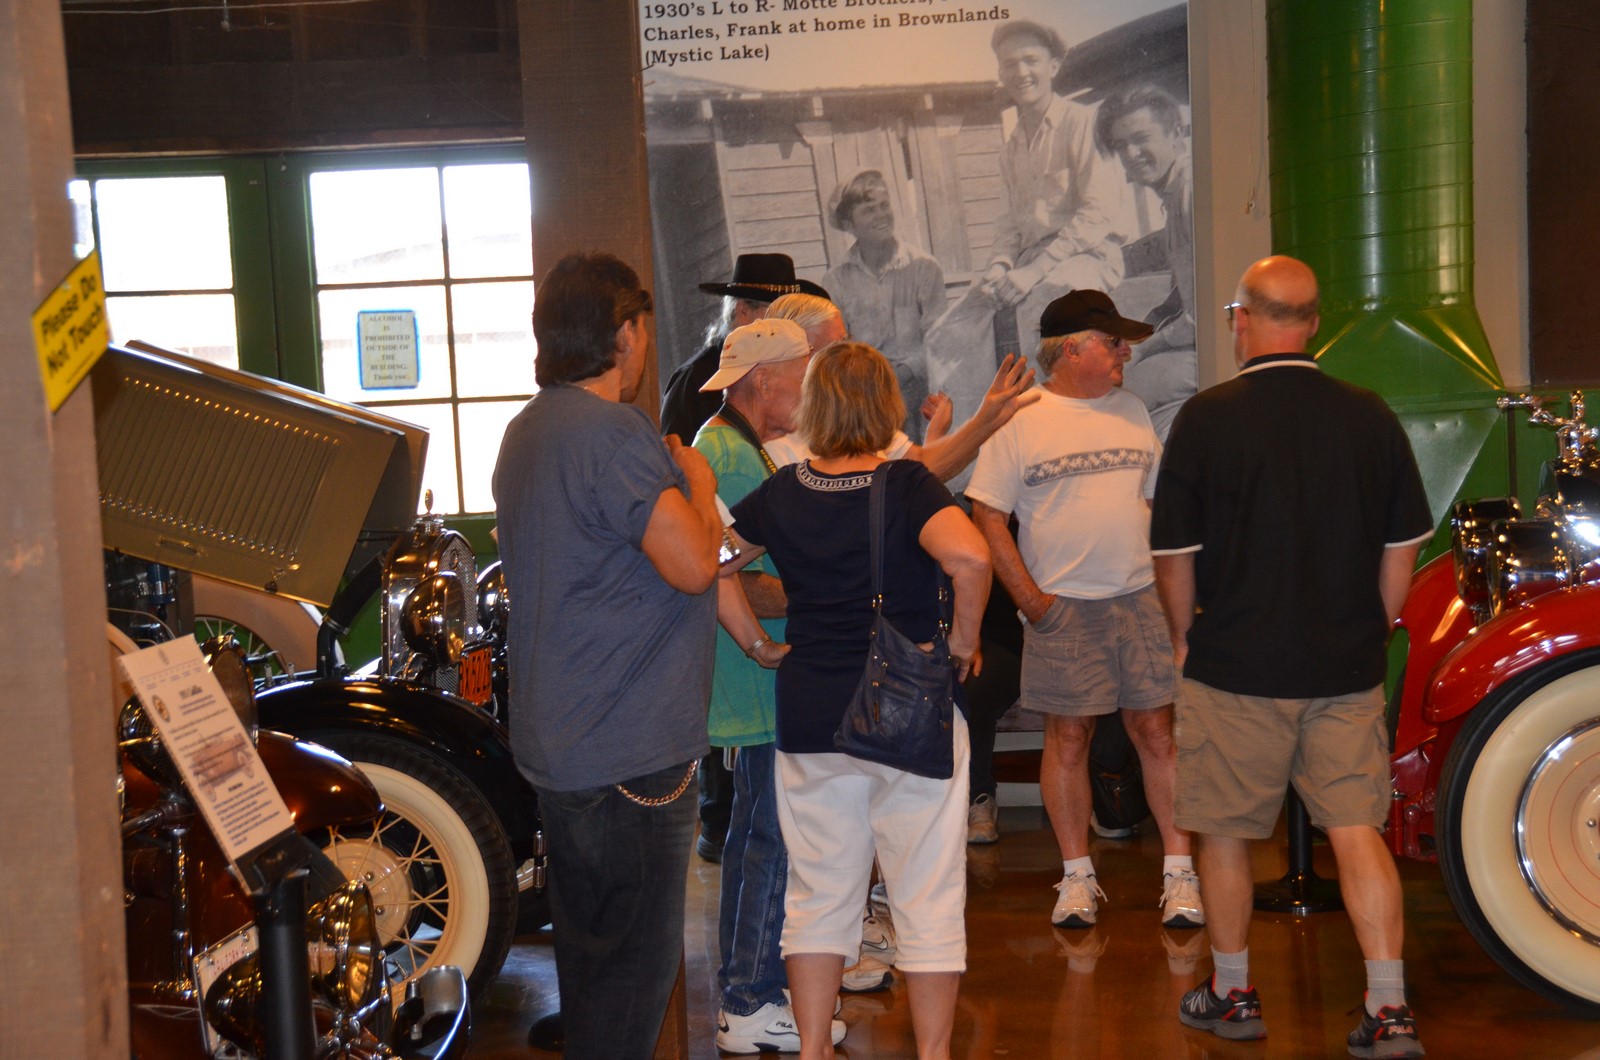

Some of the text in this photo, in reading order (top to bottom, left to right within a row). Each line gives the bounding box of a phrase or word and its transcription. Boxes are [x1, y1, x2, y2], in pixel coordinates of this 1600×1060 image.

[644, 3, 705, 19] 1930's
[712, 1, 723, 15] L
[730, 1, 748, 13] to
[756, 0, 775, 12] R-
[783, 0, 837, 11] Motte
[644, 5, 1010, 41] Charles, Frank at home in Brownlands
[645, 43, 769, 67] (Mystic Lake)
[41, 293, 79, 346] Please
[80, 274, 96, 301] Do
[369, 314, 403, 322] ALCOHOL
[47, 337, 71, 378] Not
[69, 302, 103, 351] Touch
[365, 334, 411, 342] PROHIBITED
[366, 344, 398, 352] OUTSIDE
[776, 1020, 793, 1029] FILA
[1388, 1024, 1414, 1035] FILA
